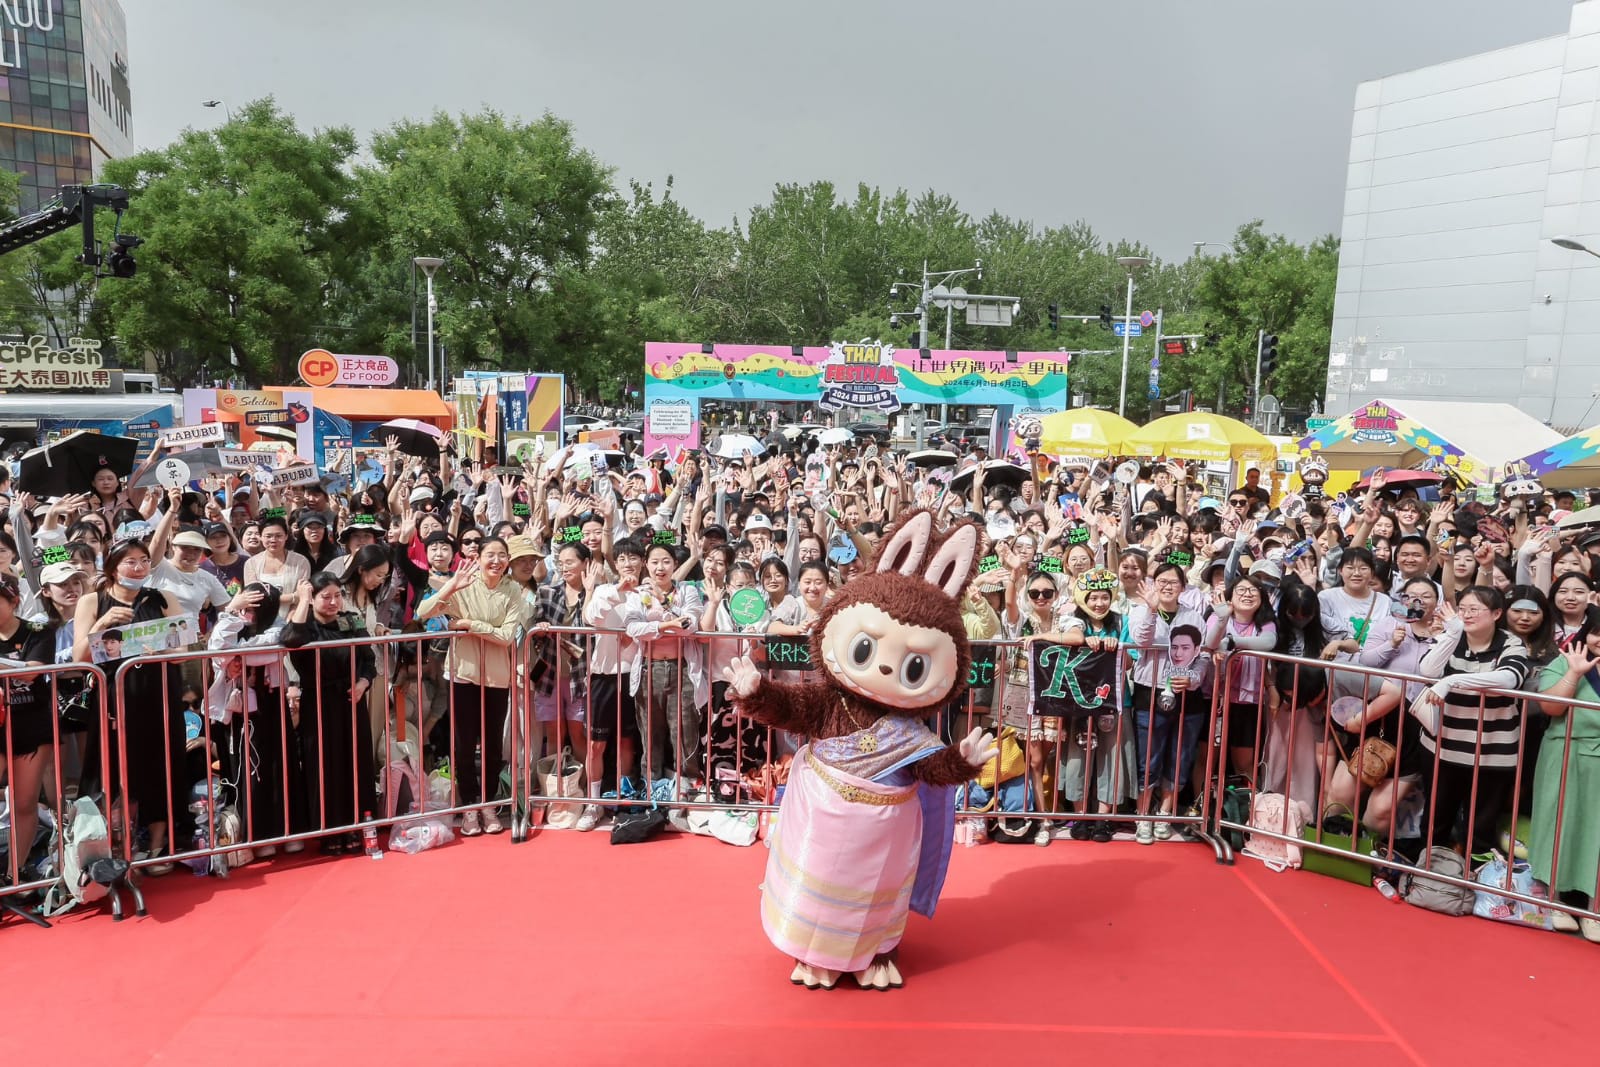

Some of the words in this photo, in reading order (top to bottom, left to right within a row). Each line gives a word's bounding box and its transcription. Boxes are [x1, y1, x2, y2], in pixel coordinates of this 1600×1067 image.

[843, 346, 880, 364] THAI
[304, 360, 334, 377] CP
[342, 359, 388, 371] 正大食品
[912, 359, 1064, 375] 让世界遇见三里屯
[359, 373, 389, 381] FOOD
[826, 364, 898, 383] FESTIVAL
[240, 396, 278, 407] Selection
[832, 389, 850, 401] 2024
[1366, 406, 1388, 417] THAI
[166, 426, 218, 442] LABUBU
[225, 455, 273, 465] LABUBU
[271, 468, 313, 486] ABUBU
[121, 622, 167, 640] KRIST
[1039, 644, 1104, 709] K
